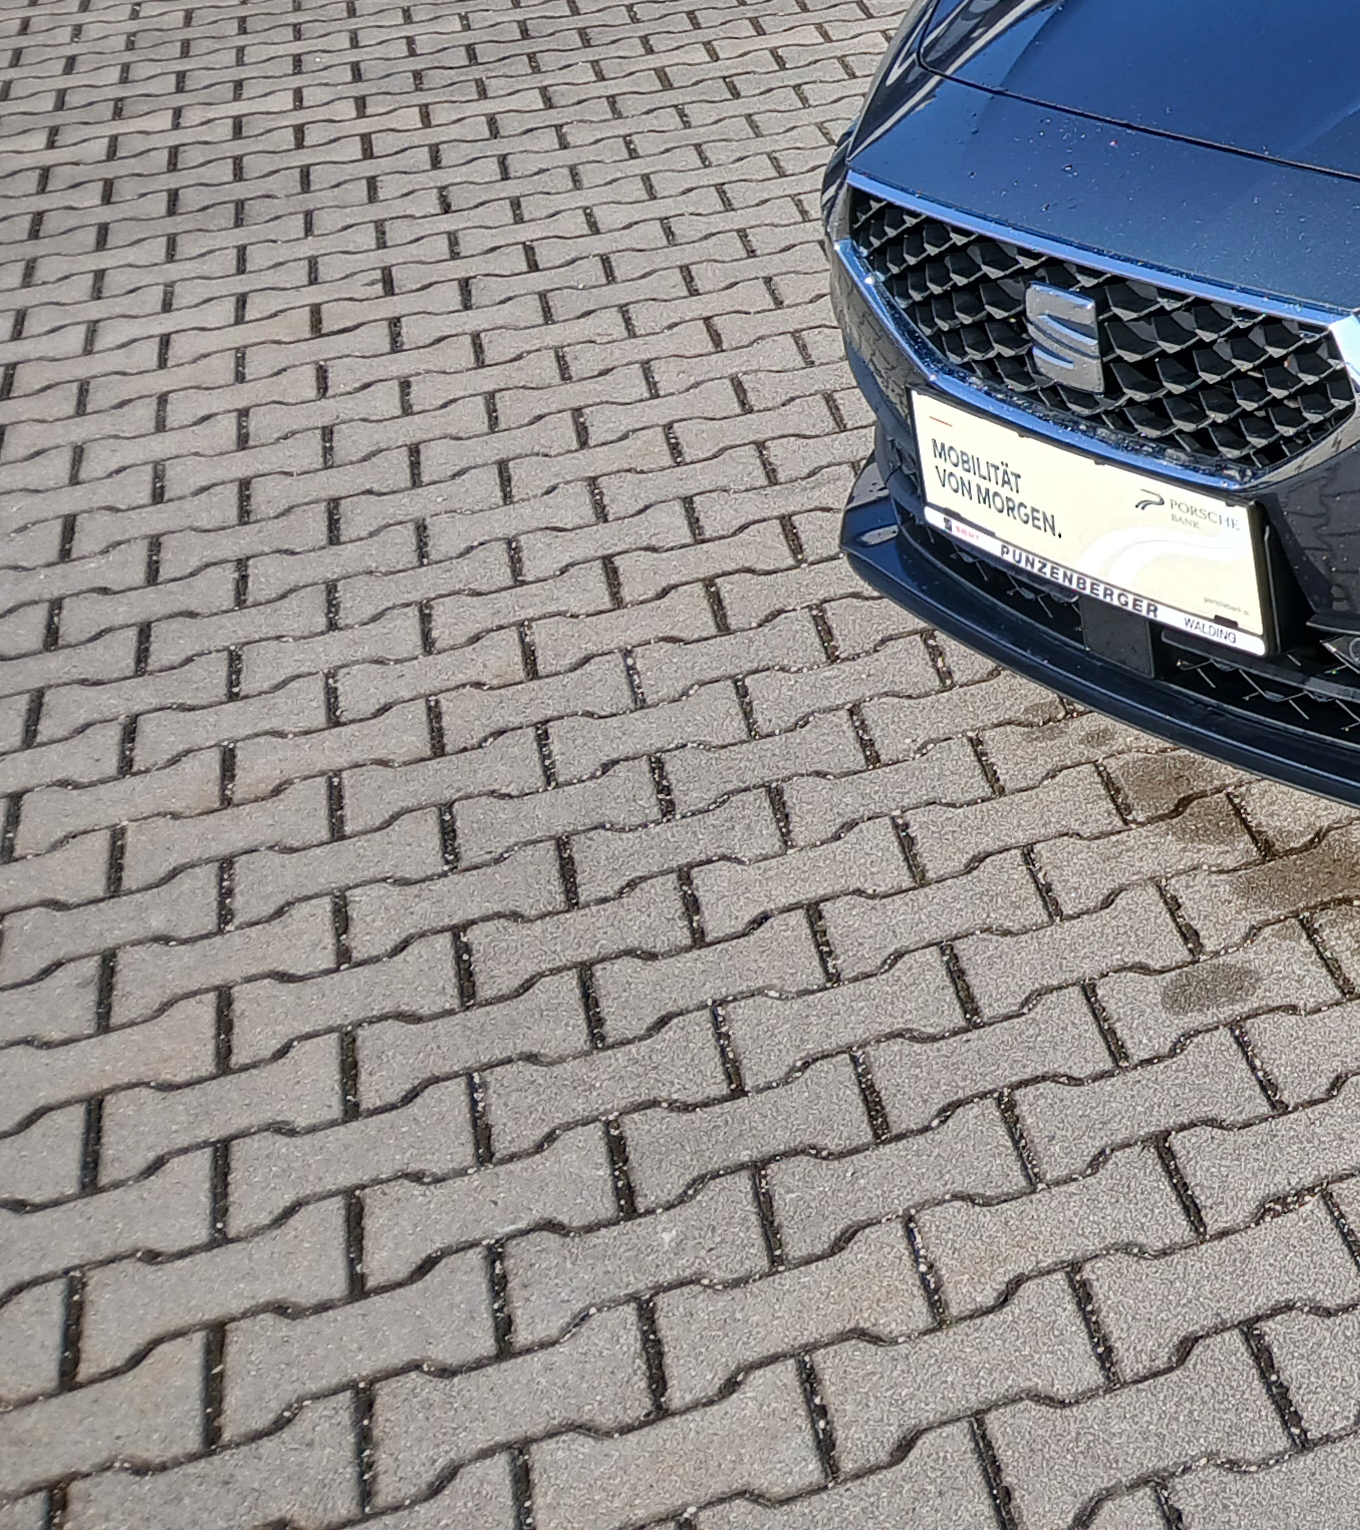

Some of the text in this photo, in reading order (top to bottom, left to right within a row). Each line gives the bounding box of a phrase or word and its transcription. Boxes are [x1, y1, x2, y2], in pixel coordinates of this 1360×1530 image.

[932, 438, 1021, 494] MOBILITÄT
[935, 465, 1062, 539] VON MORGEN.
[1170, 498, 1241, 531] PORSCHE
[1171, 513, 1201, 530] BANK
[1000, 544, 1159, 619] PUNZENBERGER
[1184, 617, 1238, 644] WALDING
